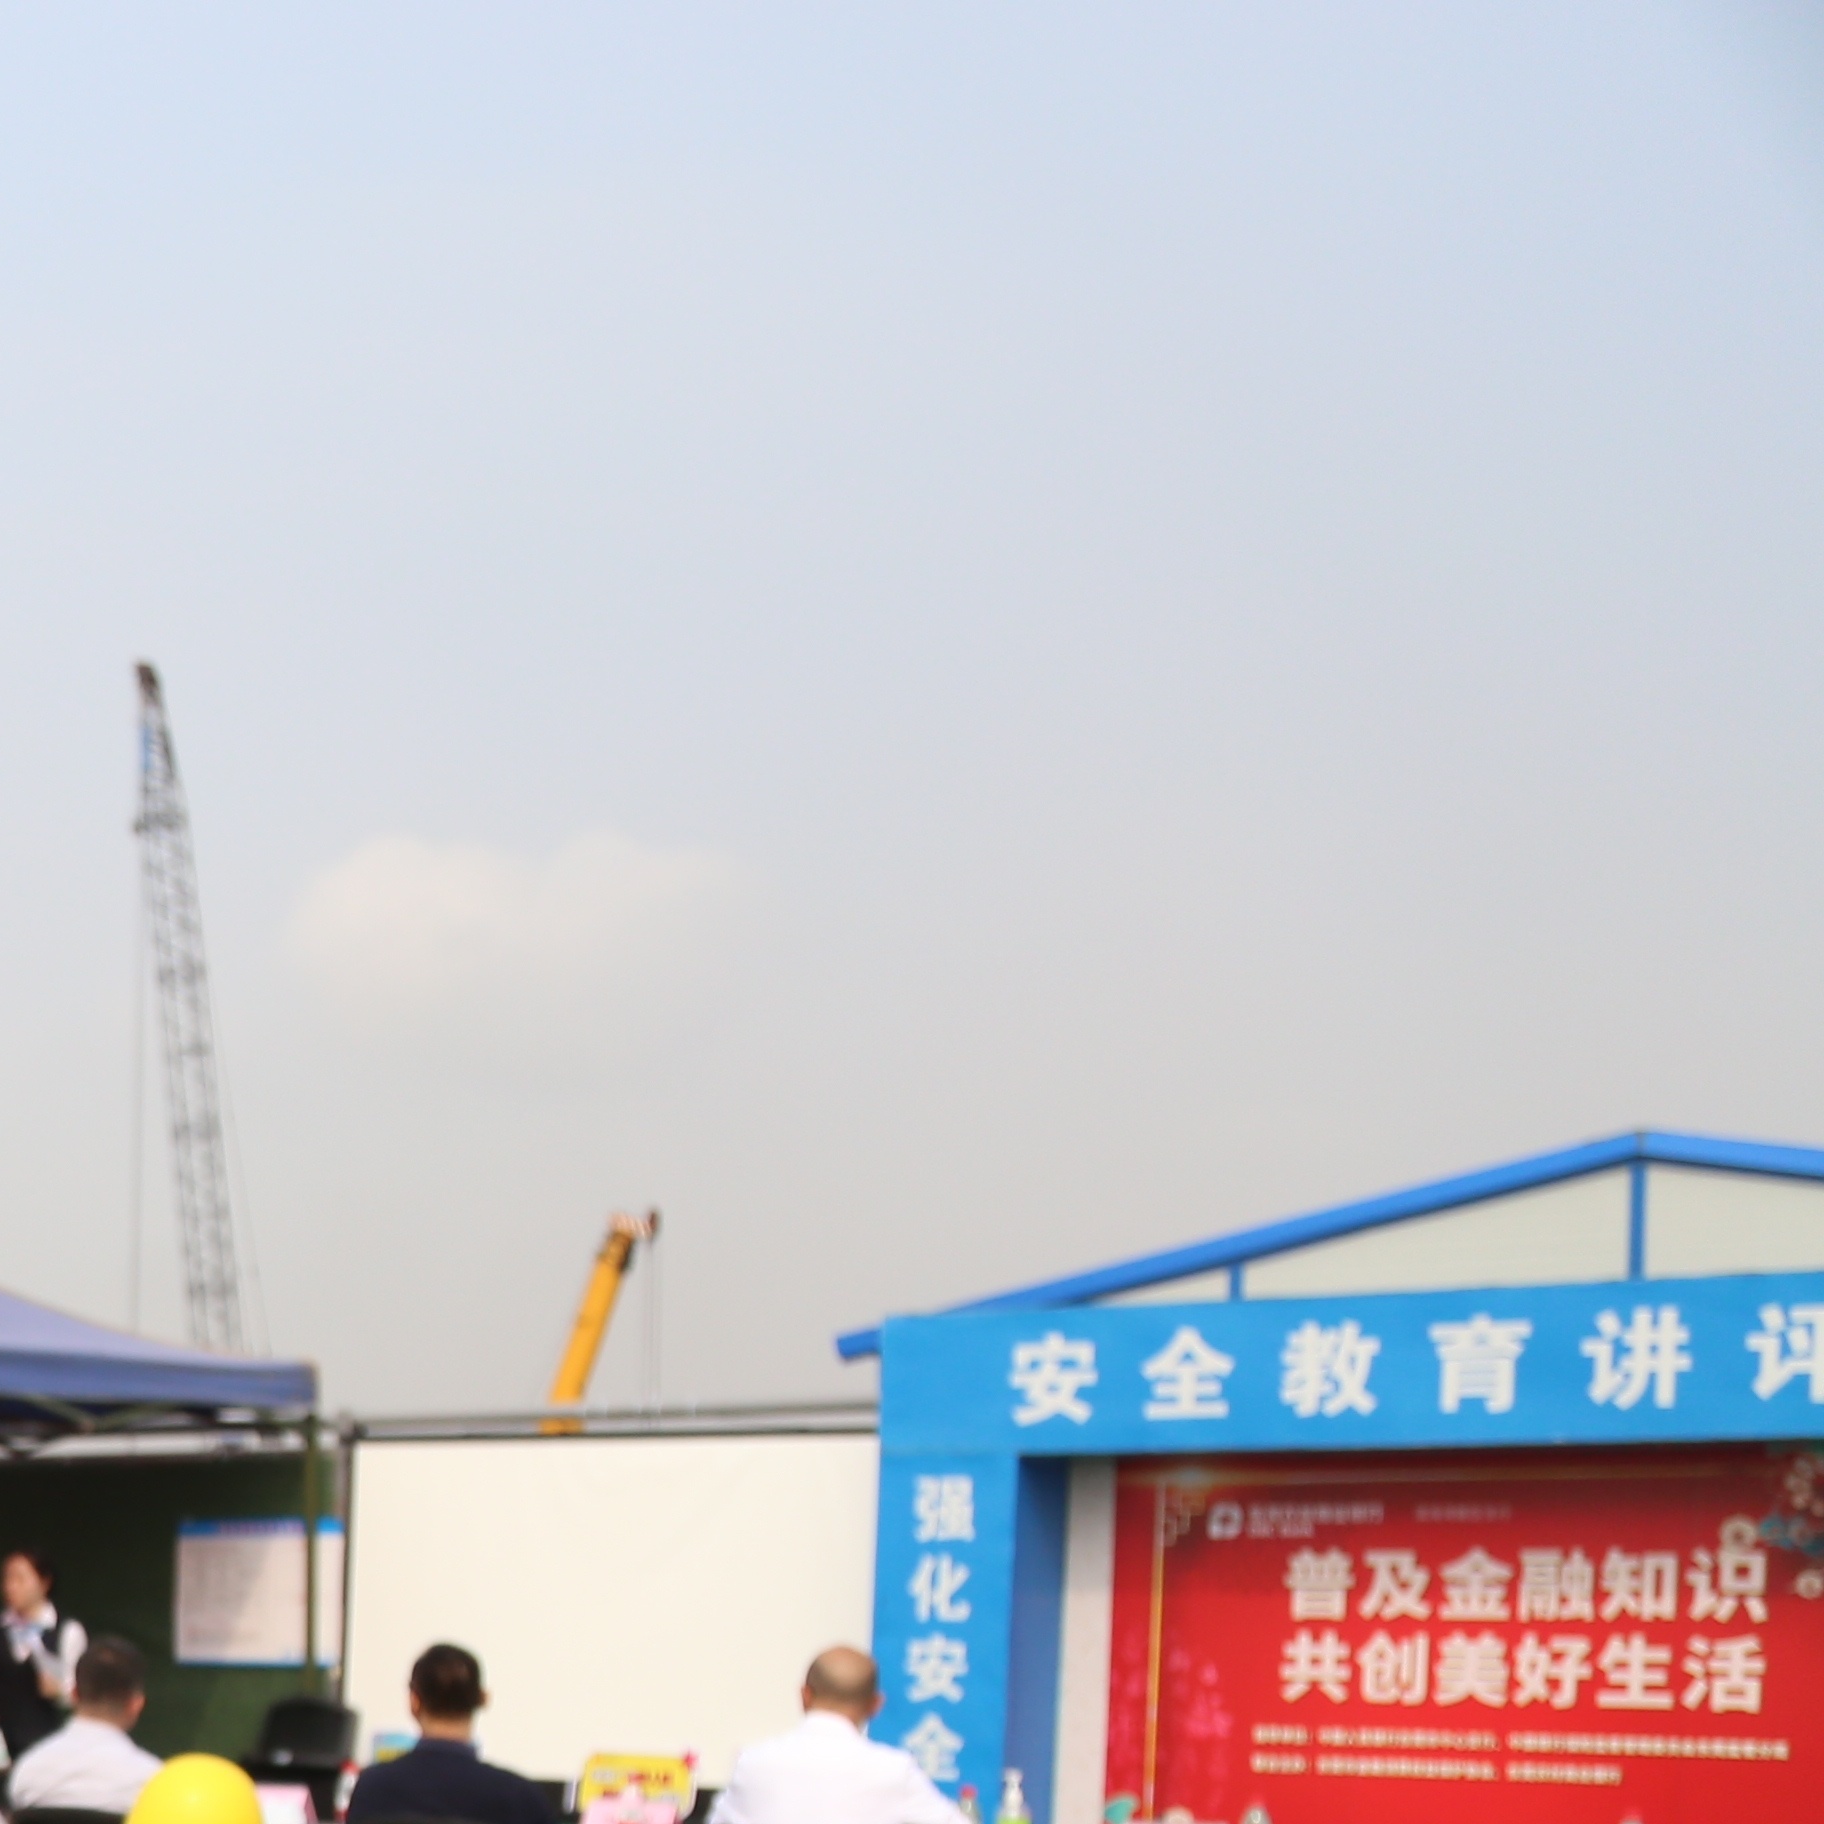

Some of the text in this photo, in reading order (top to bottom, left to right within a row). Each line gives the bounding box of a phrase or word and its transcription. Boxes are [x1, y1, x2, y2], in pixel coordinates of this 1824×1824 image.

[1009, 1303, 1824, 1427] 安全教育讲评
[1283, 1547, 1770, 1626] 普及金融知识
[1280, 1634, 1767, 1713] 共创美好生活
